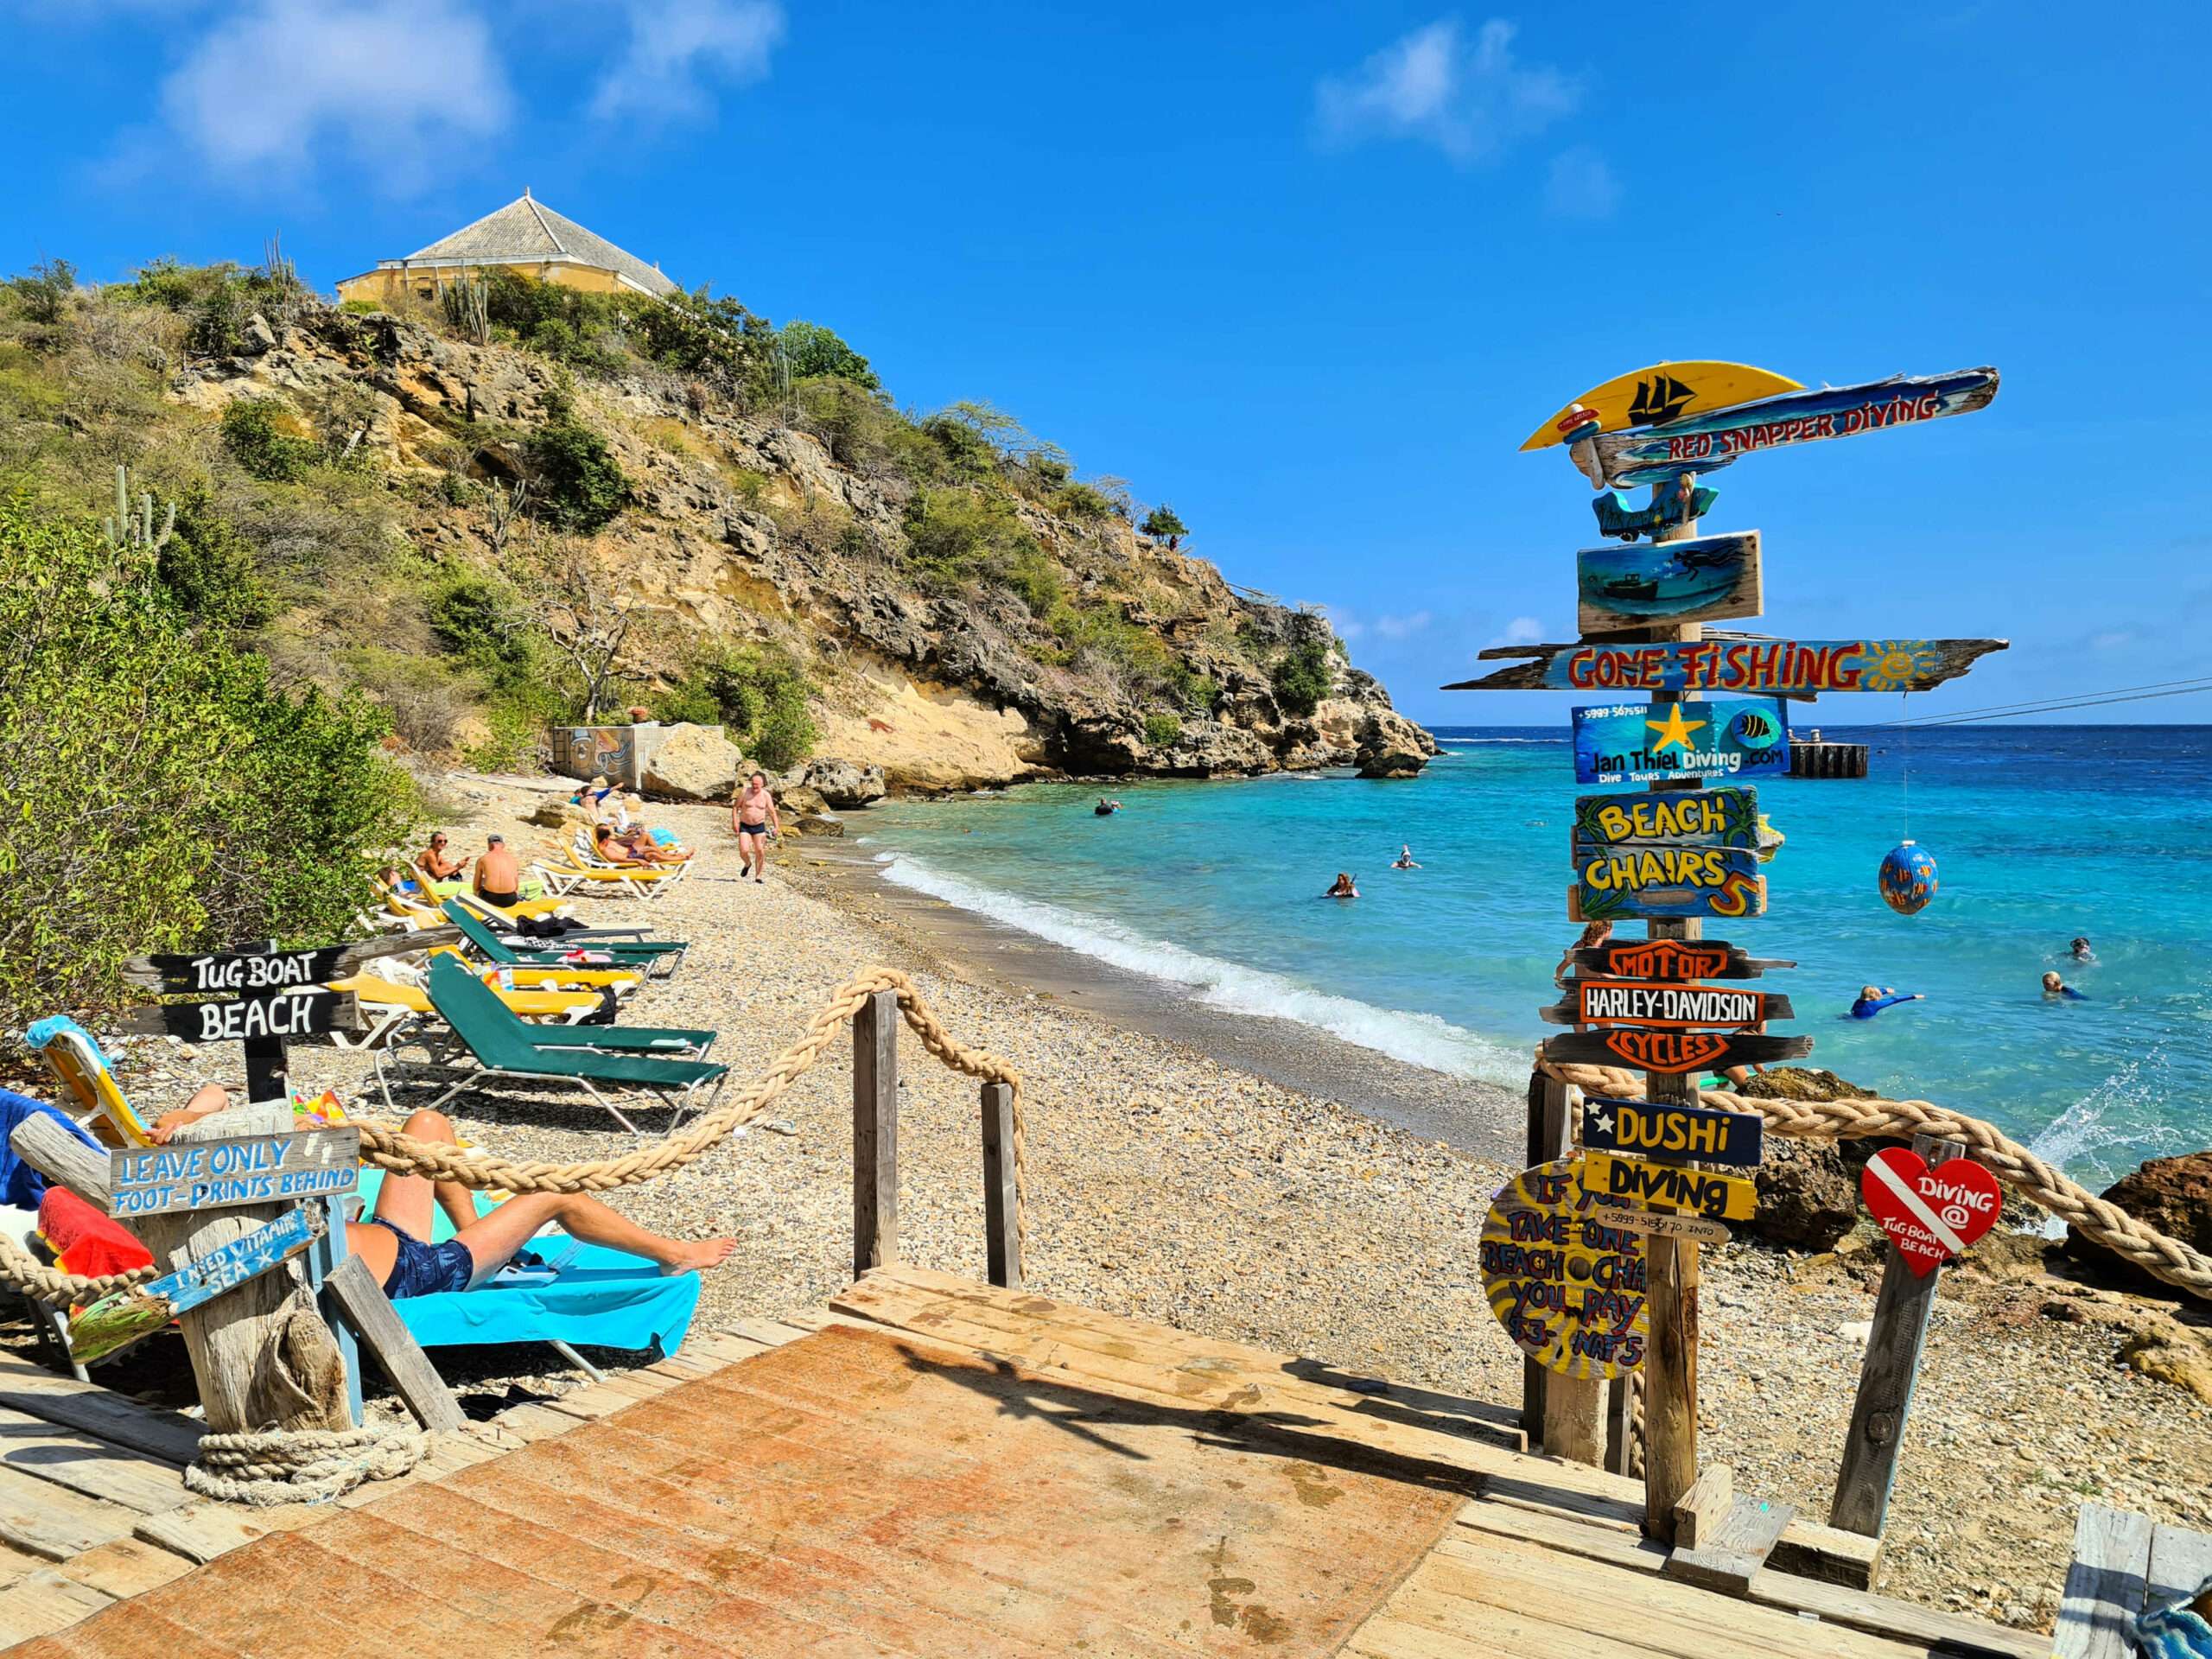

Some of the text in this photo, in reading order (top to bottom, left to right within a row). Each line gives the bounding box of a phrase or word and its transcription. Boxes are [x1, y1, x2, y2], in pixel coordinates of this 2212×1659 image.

[1669, 434, 1712, 460] RED
[1719, 415, 1835, 455] SNAPPER
[1568, 648, 1666, 689] GONE
[1590, 753, 1624, 772] Jan
[1630, 747, 1680, 770] Thiel
[1682, 748, 1742, 773] Diving
[1599, 772, 1622, 783] Dive
[1598, 796, 1726, 842] BEACH
[1585, 849, 1728, 891] CHAIRS
[246, 951, 317, 987] BOAT
[1622, 947, 1713, 978] MOTOR
[199, 995, 314, 1040] BEACH
[1586, 988, 1757, 1022] HARLEY-DAVIDSON
[1619, 1032, 1712, 1065] CYCLES
[120, 1139, 292, 1186] LEAVE ONLY
[279, 1166, 356, 1195] BEHIND
[1536, 1173, 1573, 1204] IF
[1507, 1211, 1640, 1256] TAKE ONE
[1941, 1205, 1969, 1230] @
[1901, 1237, 1946, 1260] BEACH
[1908, 1225, 1939, 1245] BOAT
[175, 1274, 185, 1289] I
[208, 1261, 251, 1294] SEA
[1480, 1241, 1646, 1294] BEACH CHA
[1510, 1281, 1646, 1336] YOU PAY
